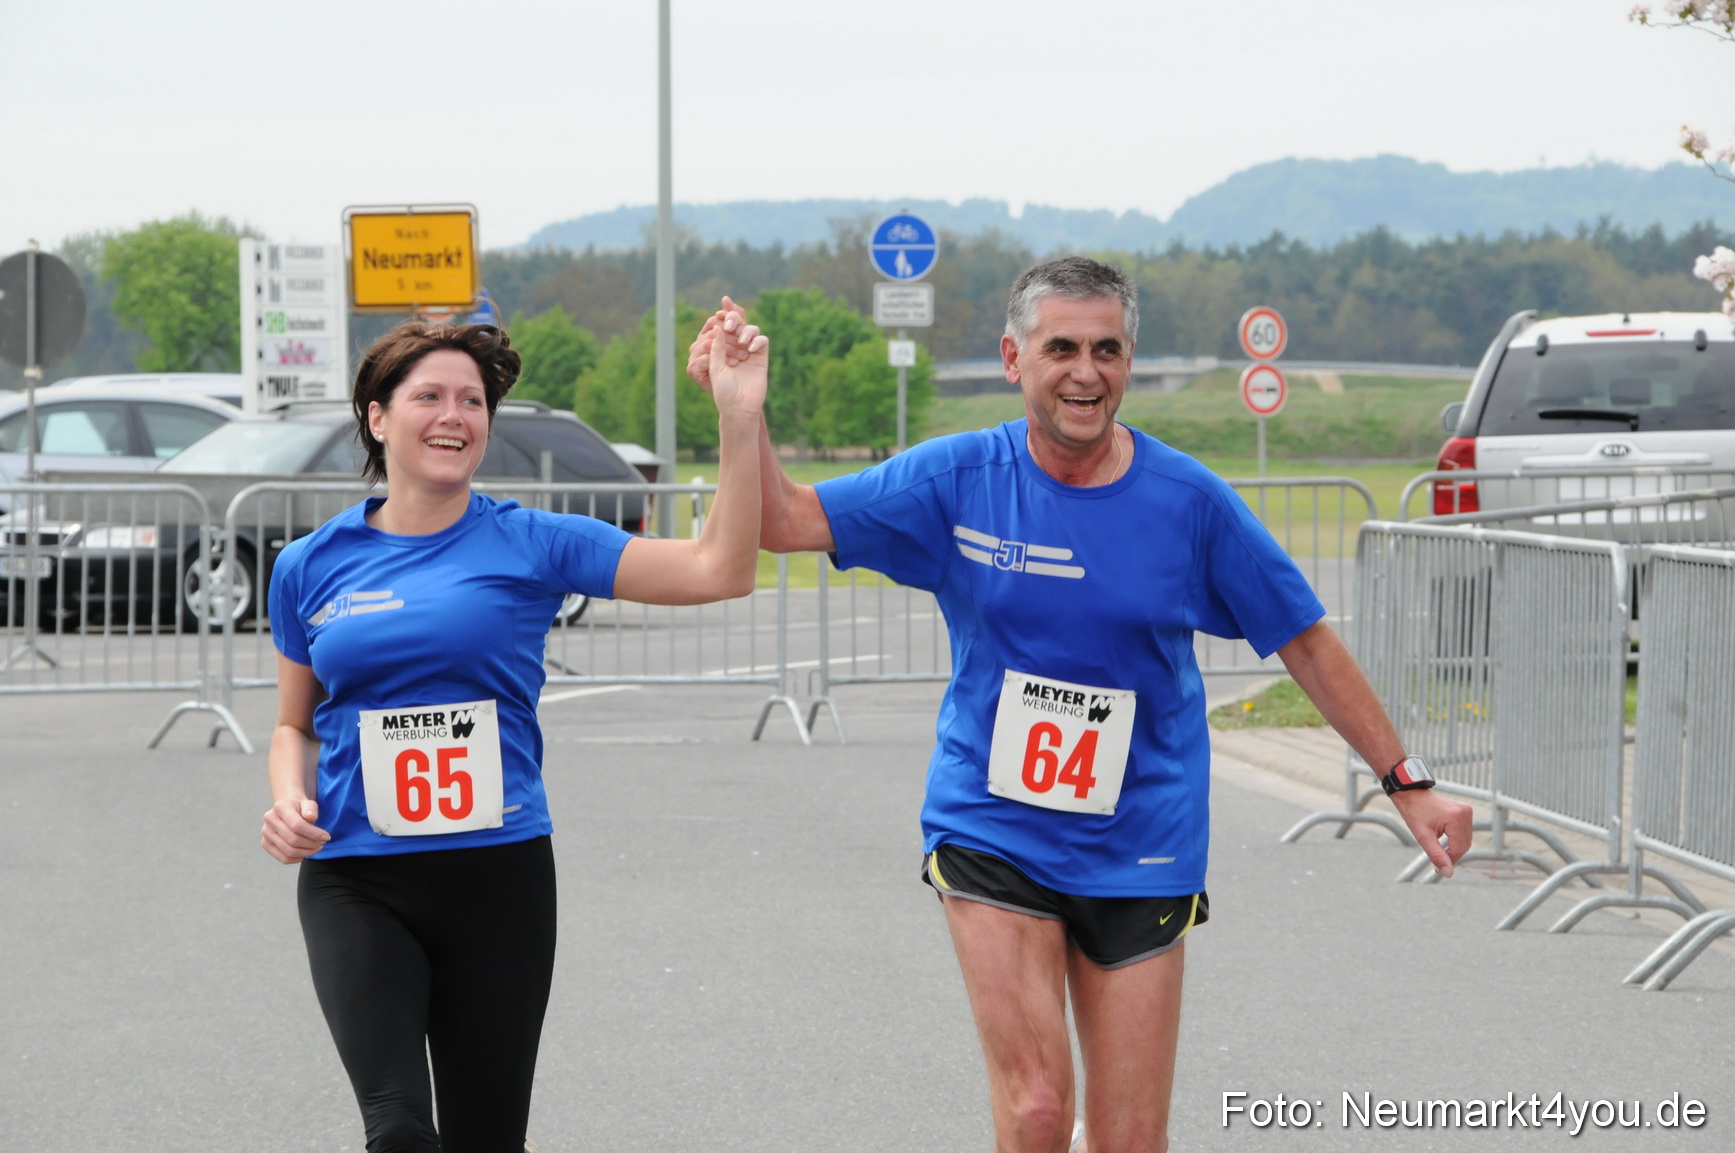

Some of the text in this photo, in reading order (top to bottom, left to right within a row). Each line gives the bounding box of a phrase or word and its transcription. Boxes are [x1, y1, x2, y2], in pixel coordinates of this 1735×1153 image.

[363, 246, 463, 269] Neumarkt
[414, 280, 433, 290] km
[1251, 322, 1277, 345] 60
[1603, 445, 1628, 456] KIA
[1023, 682, 1086, 706] MEYER
[1022, 696, 1084, 718] WERBUNG
[382, 712, 446, 730] MEYER
[382, 727, 448, 741] WERBUNG
[1021, 721, 1099, 799] 64
[395, 746, 473, 823] 65
